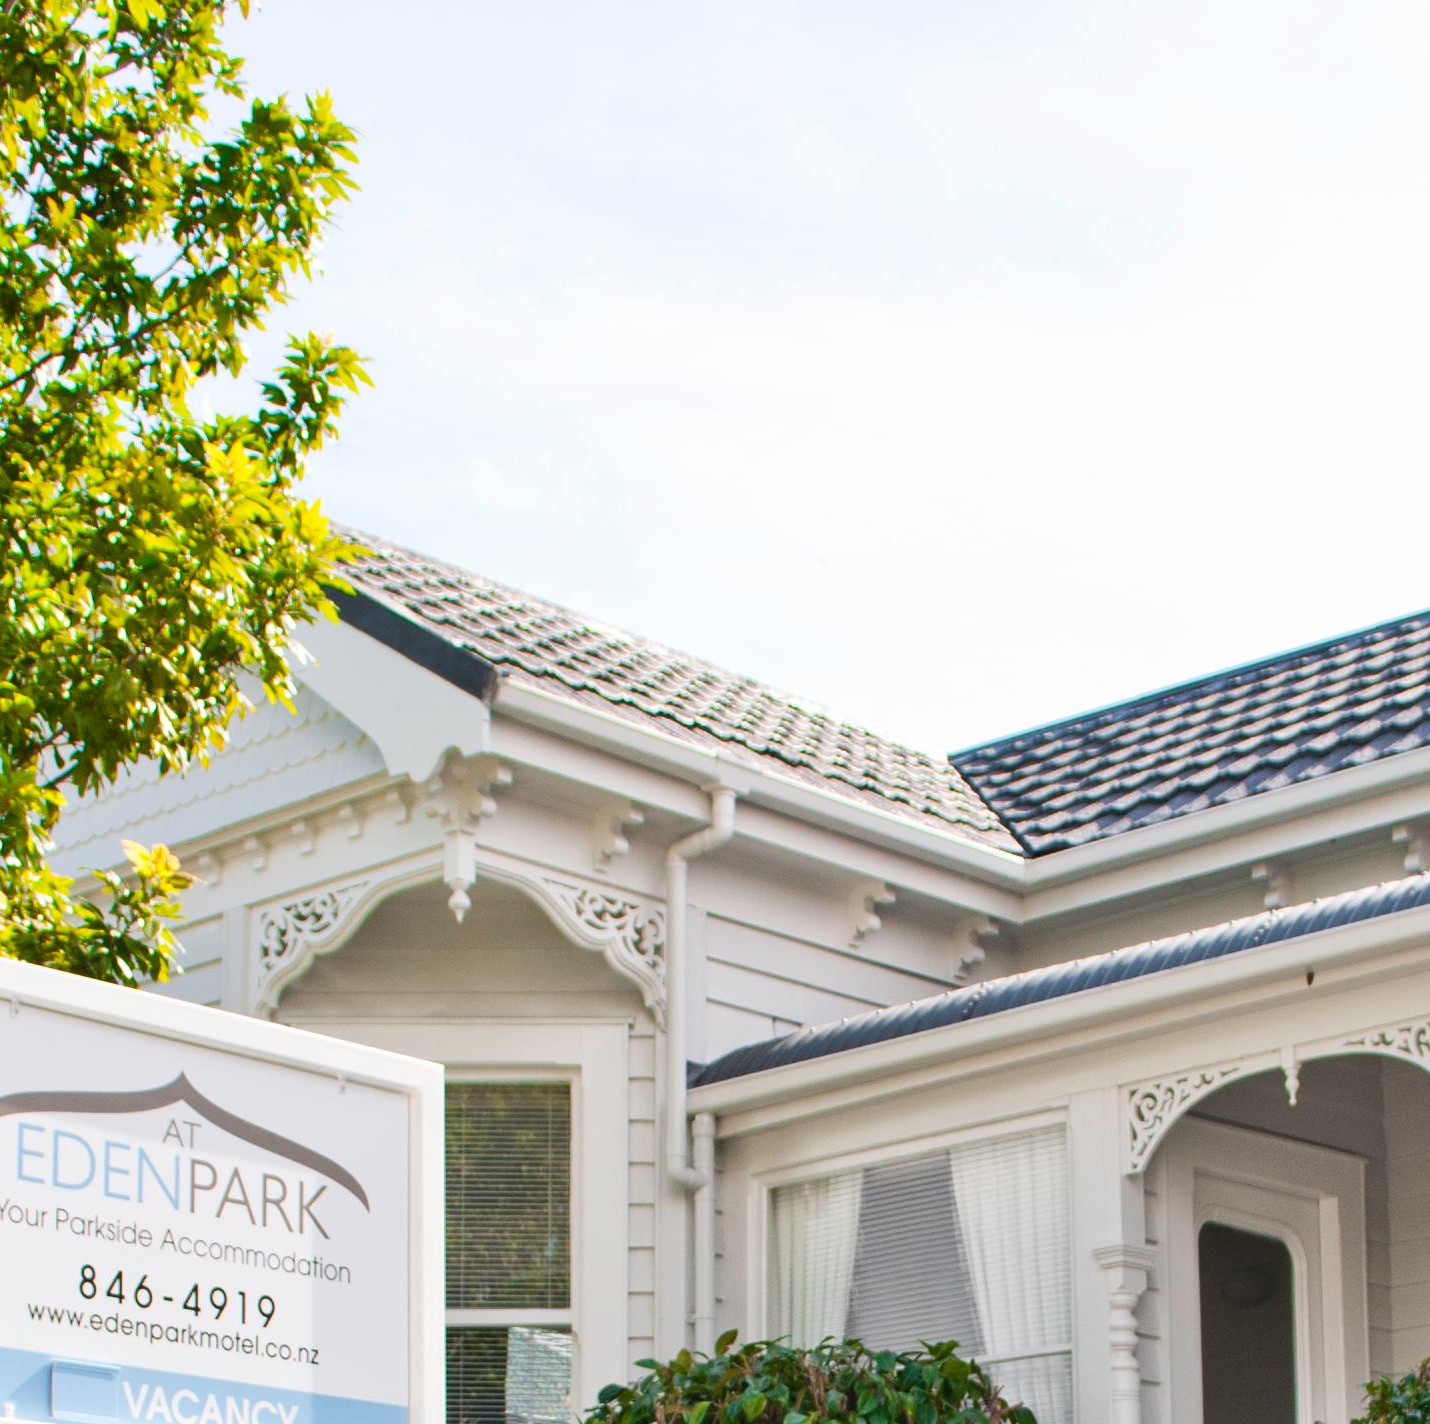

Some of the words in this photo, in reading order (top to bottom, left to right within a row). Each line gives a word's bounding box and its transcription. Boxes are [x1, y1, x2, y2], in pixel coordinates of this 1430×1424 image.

[162, 1118, 202, 1149] AT
[55, 1208, 153, 1247] Parkside
[161, 1229, 351, 1283] Accommodation
[79, 1264, 276, 1328] 846-4919
[28, 1303, 320, 1365] www.edenparkmotel.co.nz
